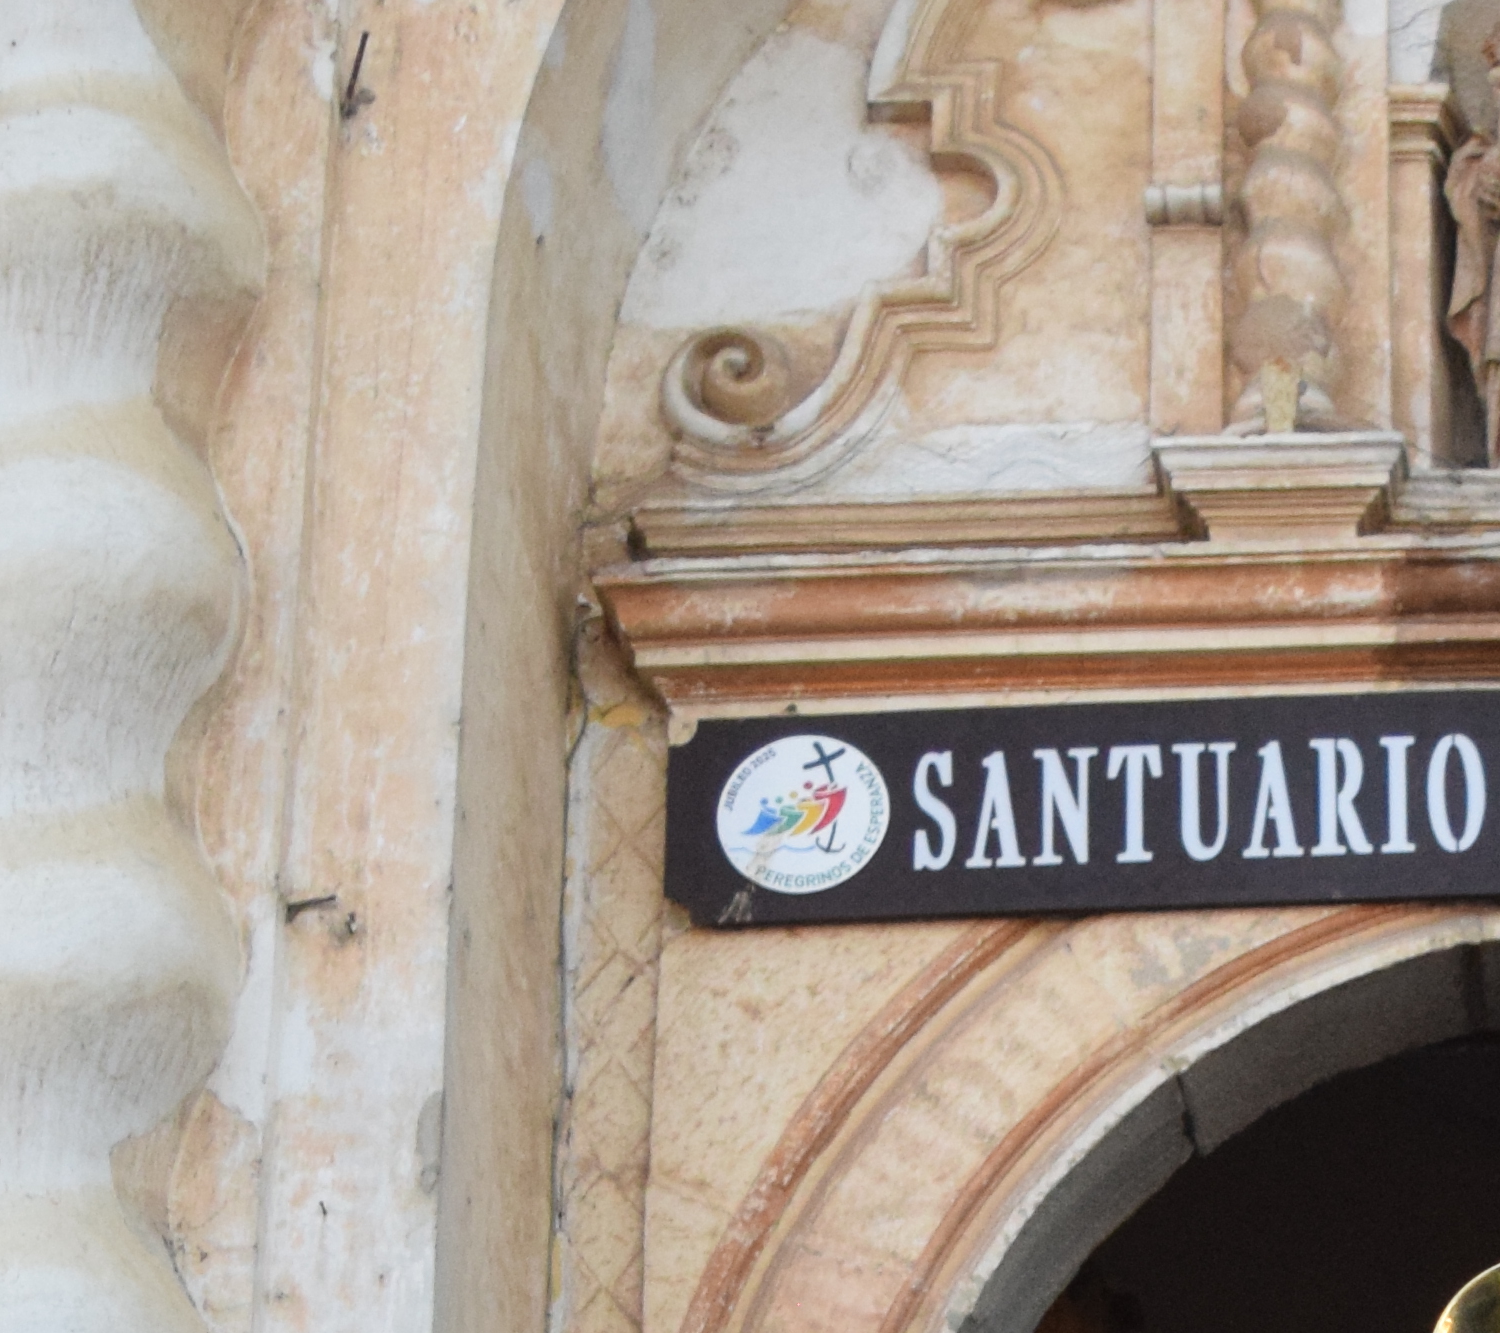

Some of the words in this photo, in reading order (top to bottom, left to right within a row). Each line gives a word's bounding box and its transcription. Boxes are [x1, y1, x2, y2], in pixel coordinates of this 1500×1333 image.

[854, 760, 884, 845] ESPERANZA
[912, 732, 1488, 872] SANTUARIO
[753, 859, 852, 889] PEREGRINOS
[850, 844, 873, 865] DE
